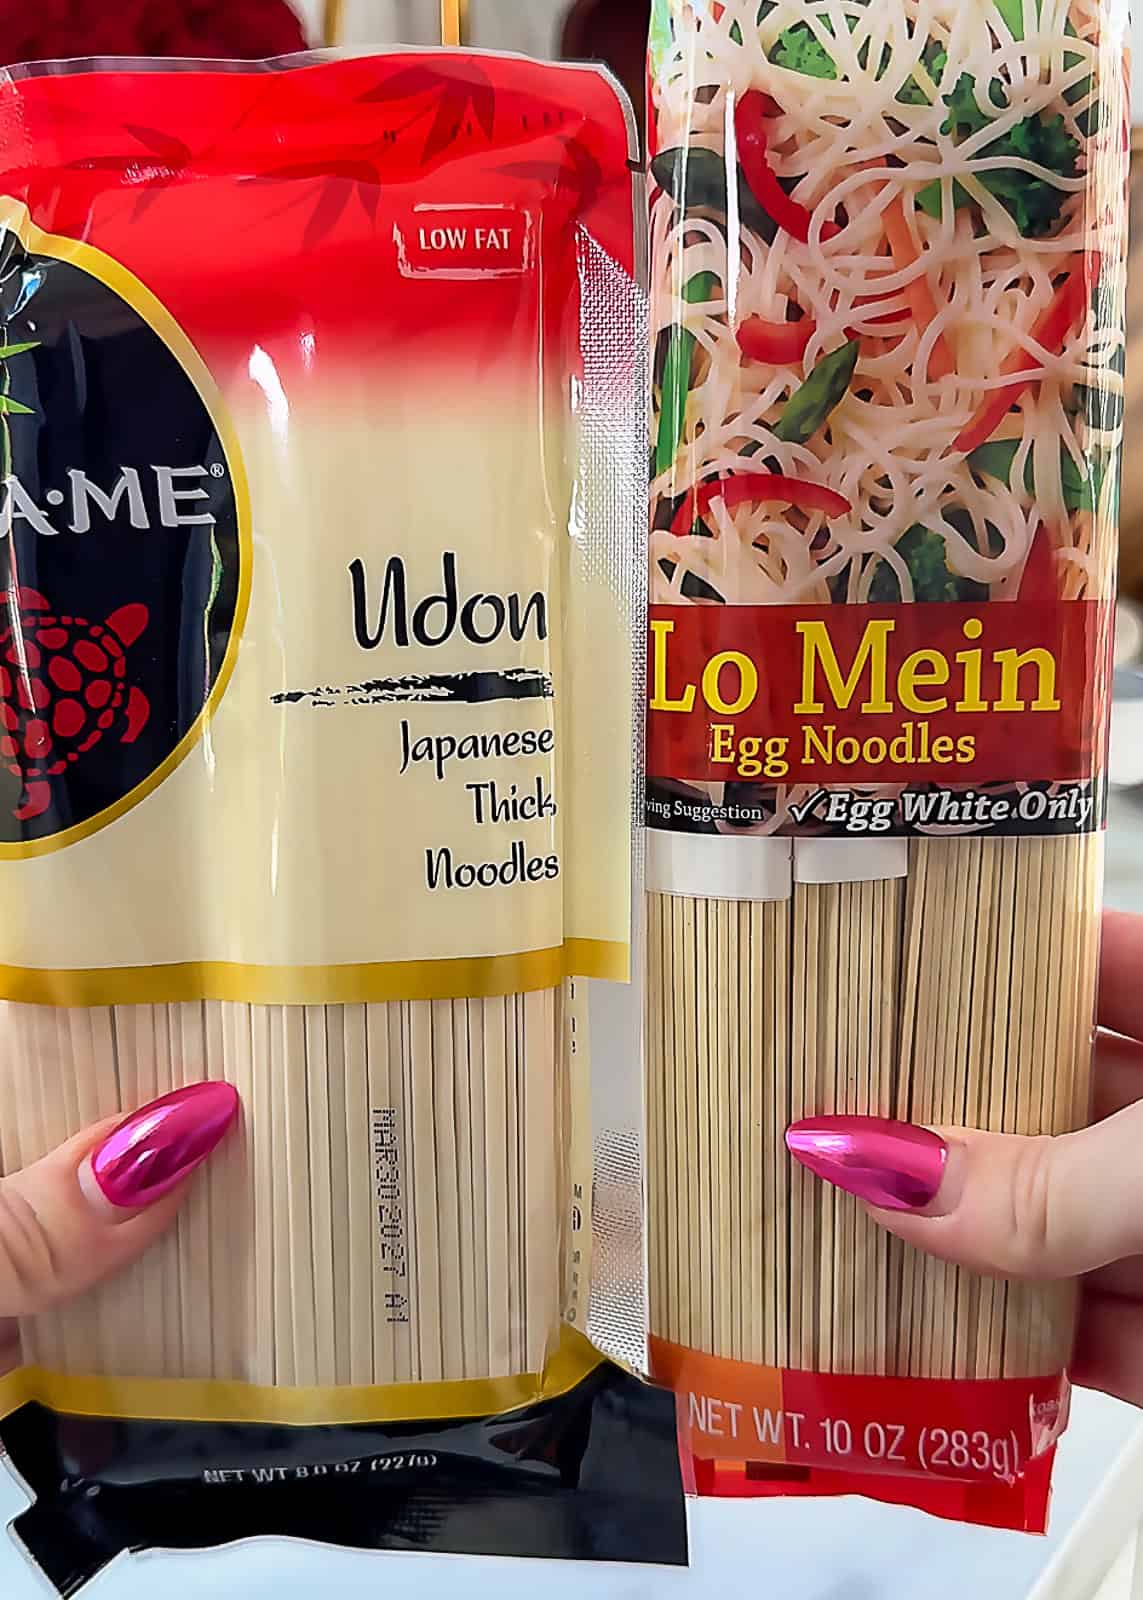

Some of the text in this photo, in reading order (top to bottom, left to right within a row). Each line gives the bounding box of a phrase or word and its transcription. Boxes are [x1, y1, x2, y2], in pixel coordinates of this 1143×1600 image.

[419, 227, 511, 250] LOW FAT
[349, 552, 548, 649] Udon
[649, 618, 1061, 715] Lo Mein
[400, 720, 554, 780] Japanese
[711, 721, 976, 777] Egg Noodles
[466, 777, 556, 824] Thick
[674, 800, 762, 822] Suggestion
[826, 788, 1094, 831] Egg White Only
[426, 841, 559, 889] Noodles
[688, 1392, 1021, 1487] NET WT. 10 OZ (283g)
[203, 1469, 245, 1483] NET
[252, 1467, 288, 1482] WT
[296, 1464, 327, 1478] 80
